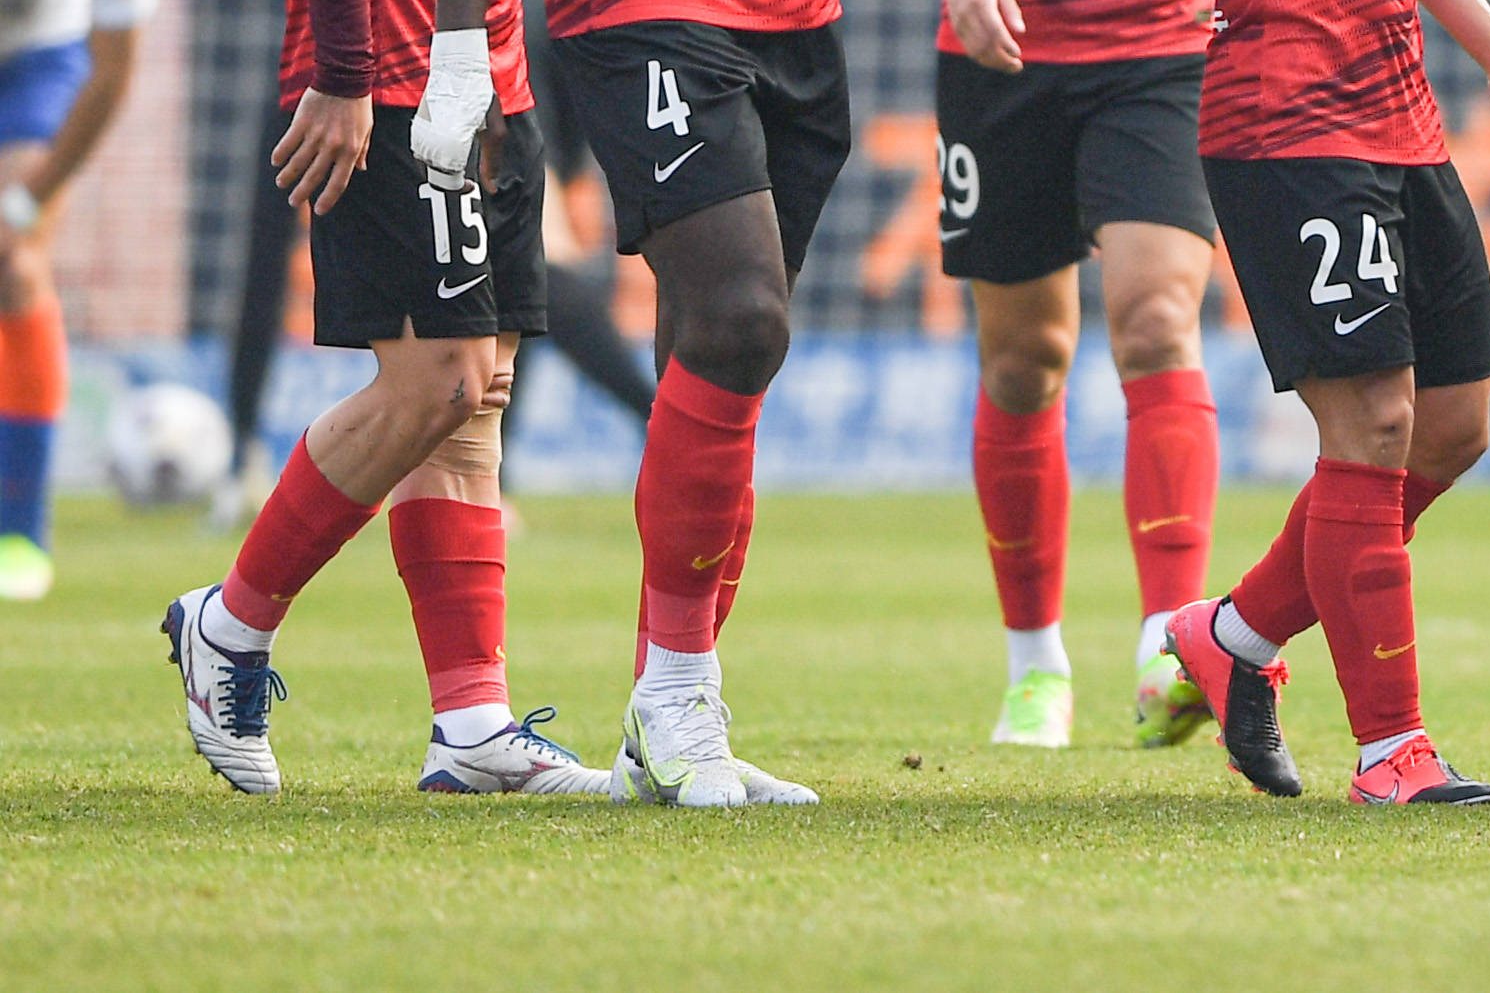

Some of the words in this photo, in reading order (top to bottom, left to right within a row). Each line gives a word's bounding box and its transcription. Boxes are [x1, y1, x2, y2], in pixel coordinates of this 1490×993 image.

[646, 59, 692, 136] 4
[418, 178, 489, 265] 15
[1299, 212, 1400, 305] 24
